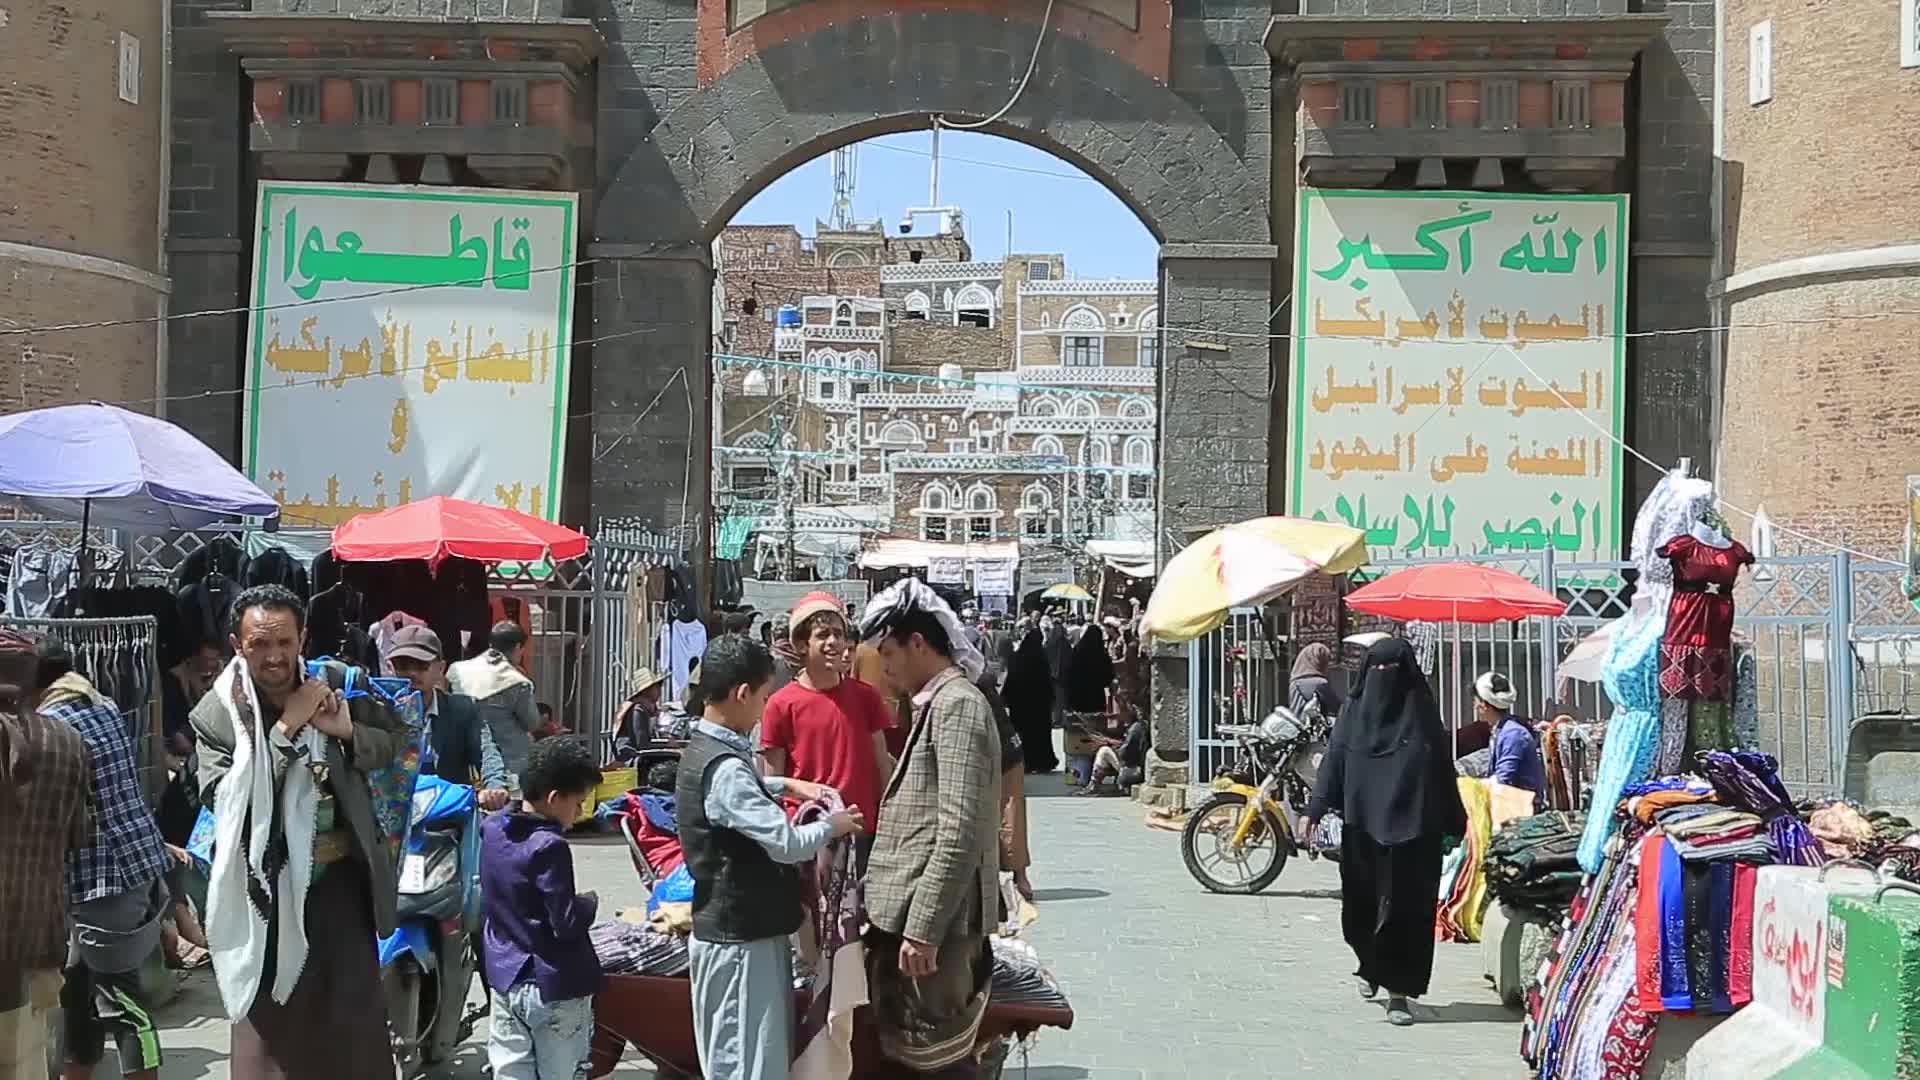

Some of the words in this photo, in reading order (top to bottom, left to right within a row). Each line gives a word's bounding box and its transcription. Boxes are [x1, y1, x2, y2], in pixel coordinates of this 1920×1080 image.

[283, 206, 531, 299] قاطعوا
[1312, 201, 1492, 290] أكبر
[1500, 211, 1609, 274] الله
[1479, 303, 1604, 350] الموت
[423, 318, 549, 397] البضائع
[1478, 368, 1602, 417] الموت
[388, 399, 408, 454] و
[1310, 431, 1416, 481] اليهود
[1431, 435, 1488, 482] على
[1507, 434, 1602, 478] اللعنة
[1480, 491, 1601, 553] النصر
